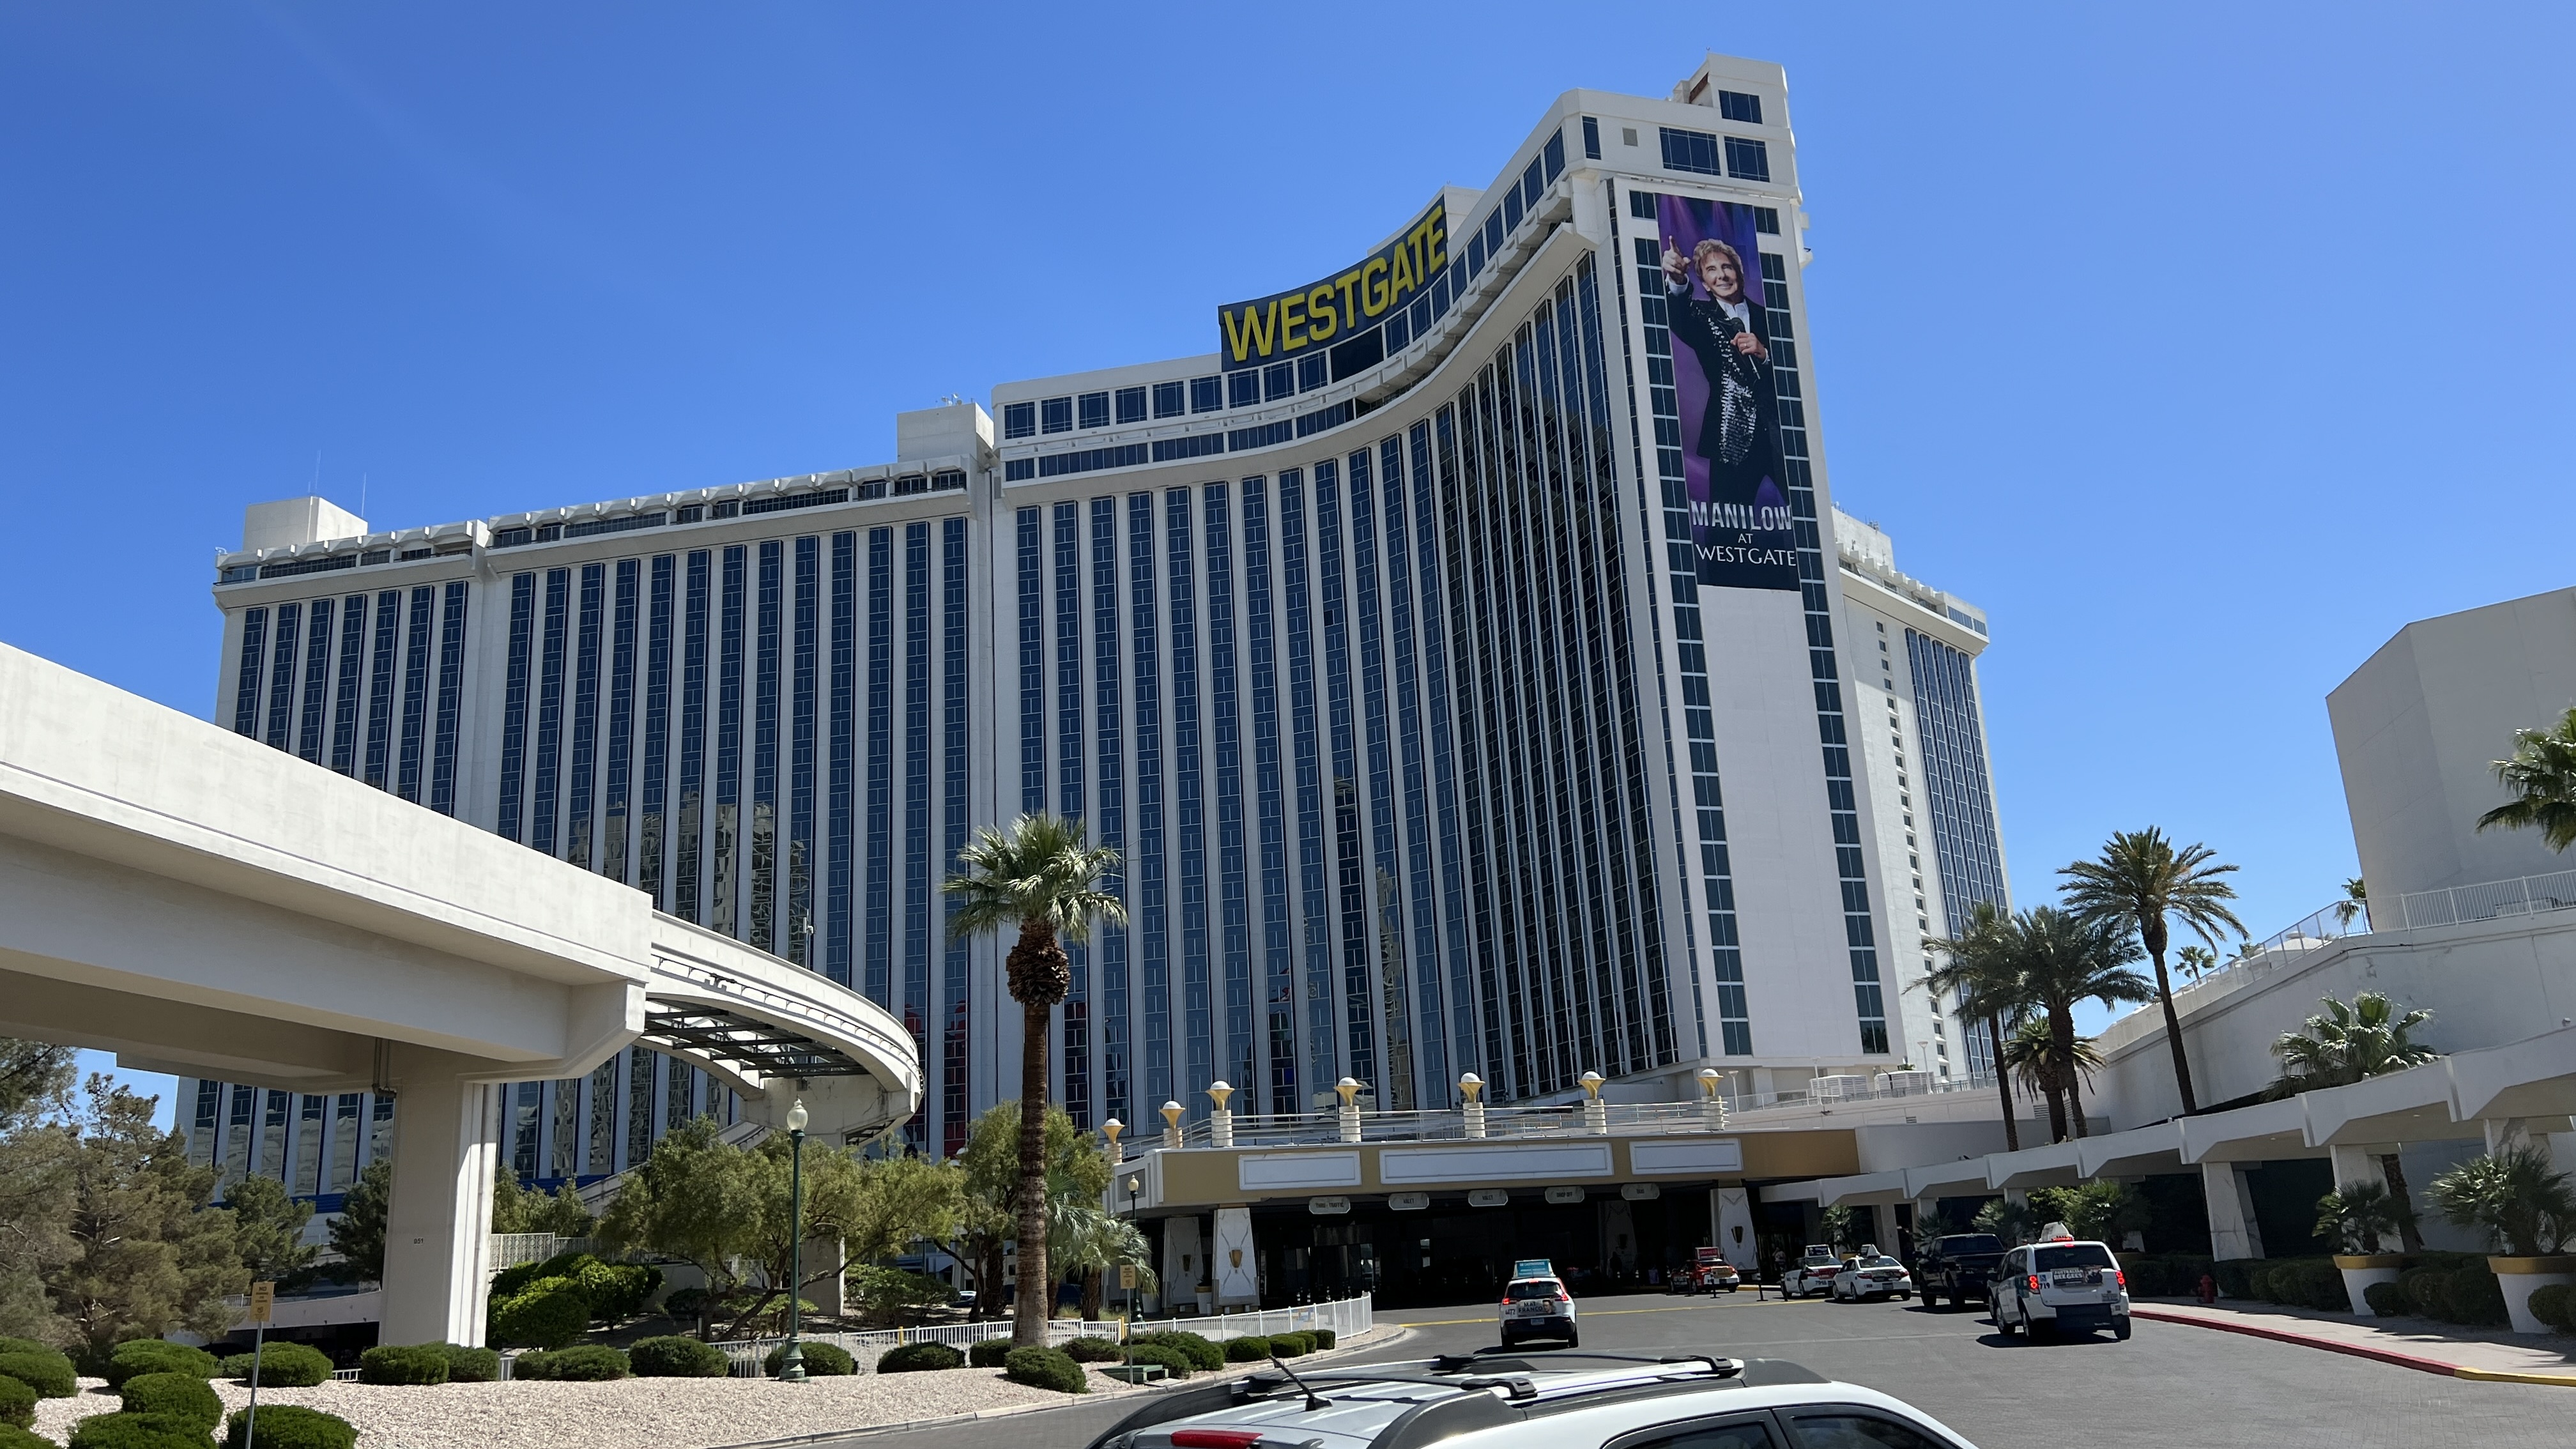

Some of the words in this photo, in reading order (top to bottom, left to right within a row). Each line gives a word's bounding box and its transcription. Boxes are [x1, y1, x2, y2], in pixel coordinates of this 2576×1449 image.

[1223, 204, 1446, 362] WESTGATE
[1690, 501, 1792, 531] MANILOW
[1738, 533, 1753, 544] AT
[1695, 544, 1797, 567] WESTGATE
